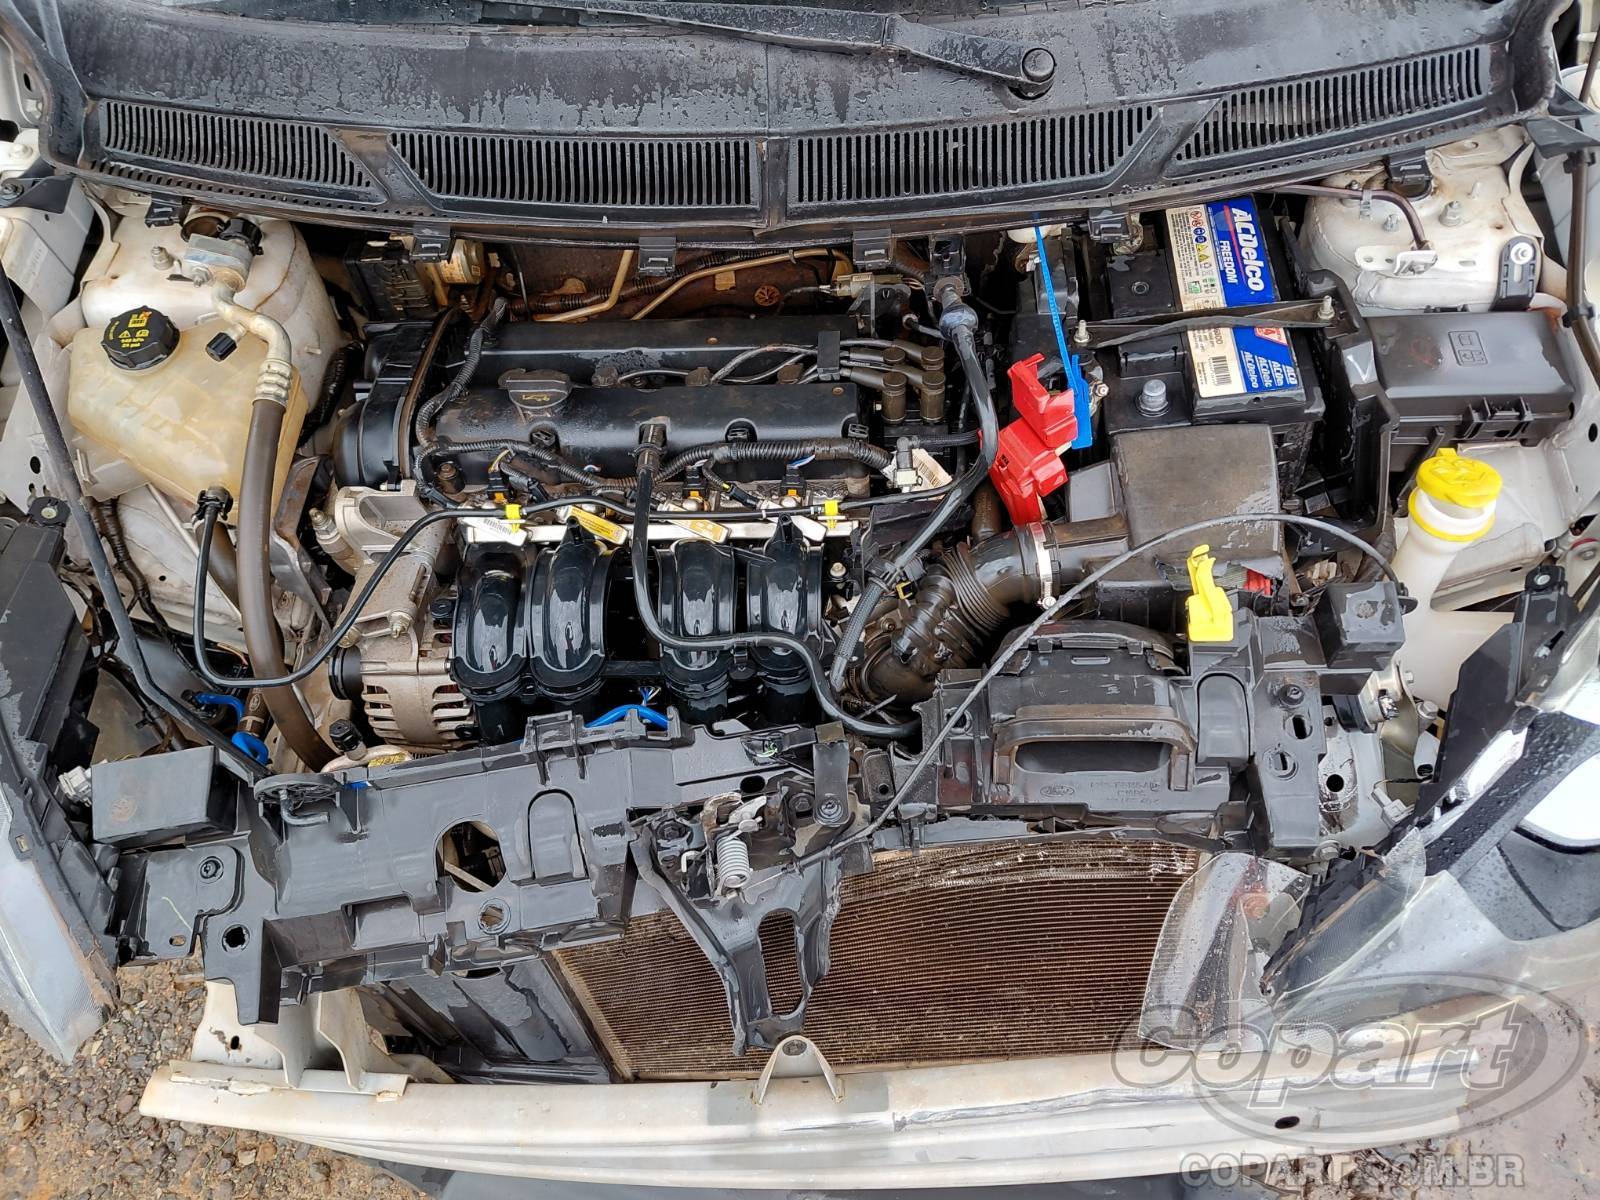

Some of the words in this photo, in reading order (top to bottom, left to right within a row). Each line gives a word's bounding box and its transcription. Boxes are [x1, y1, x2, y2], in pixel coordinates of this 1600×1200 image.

[1219, 240, 1238, 285] FREEDOM
[1231, 207, 1265, 292] ACDelco
[1244, 351, 1259, 389] ACDelco
